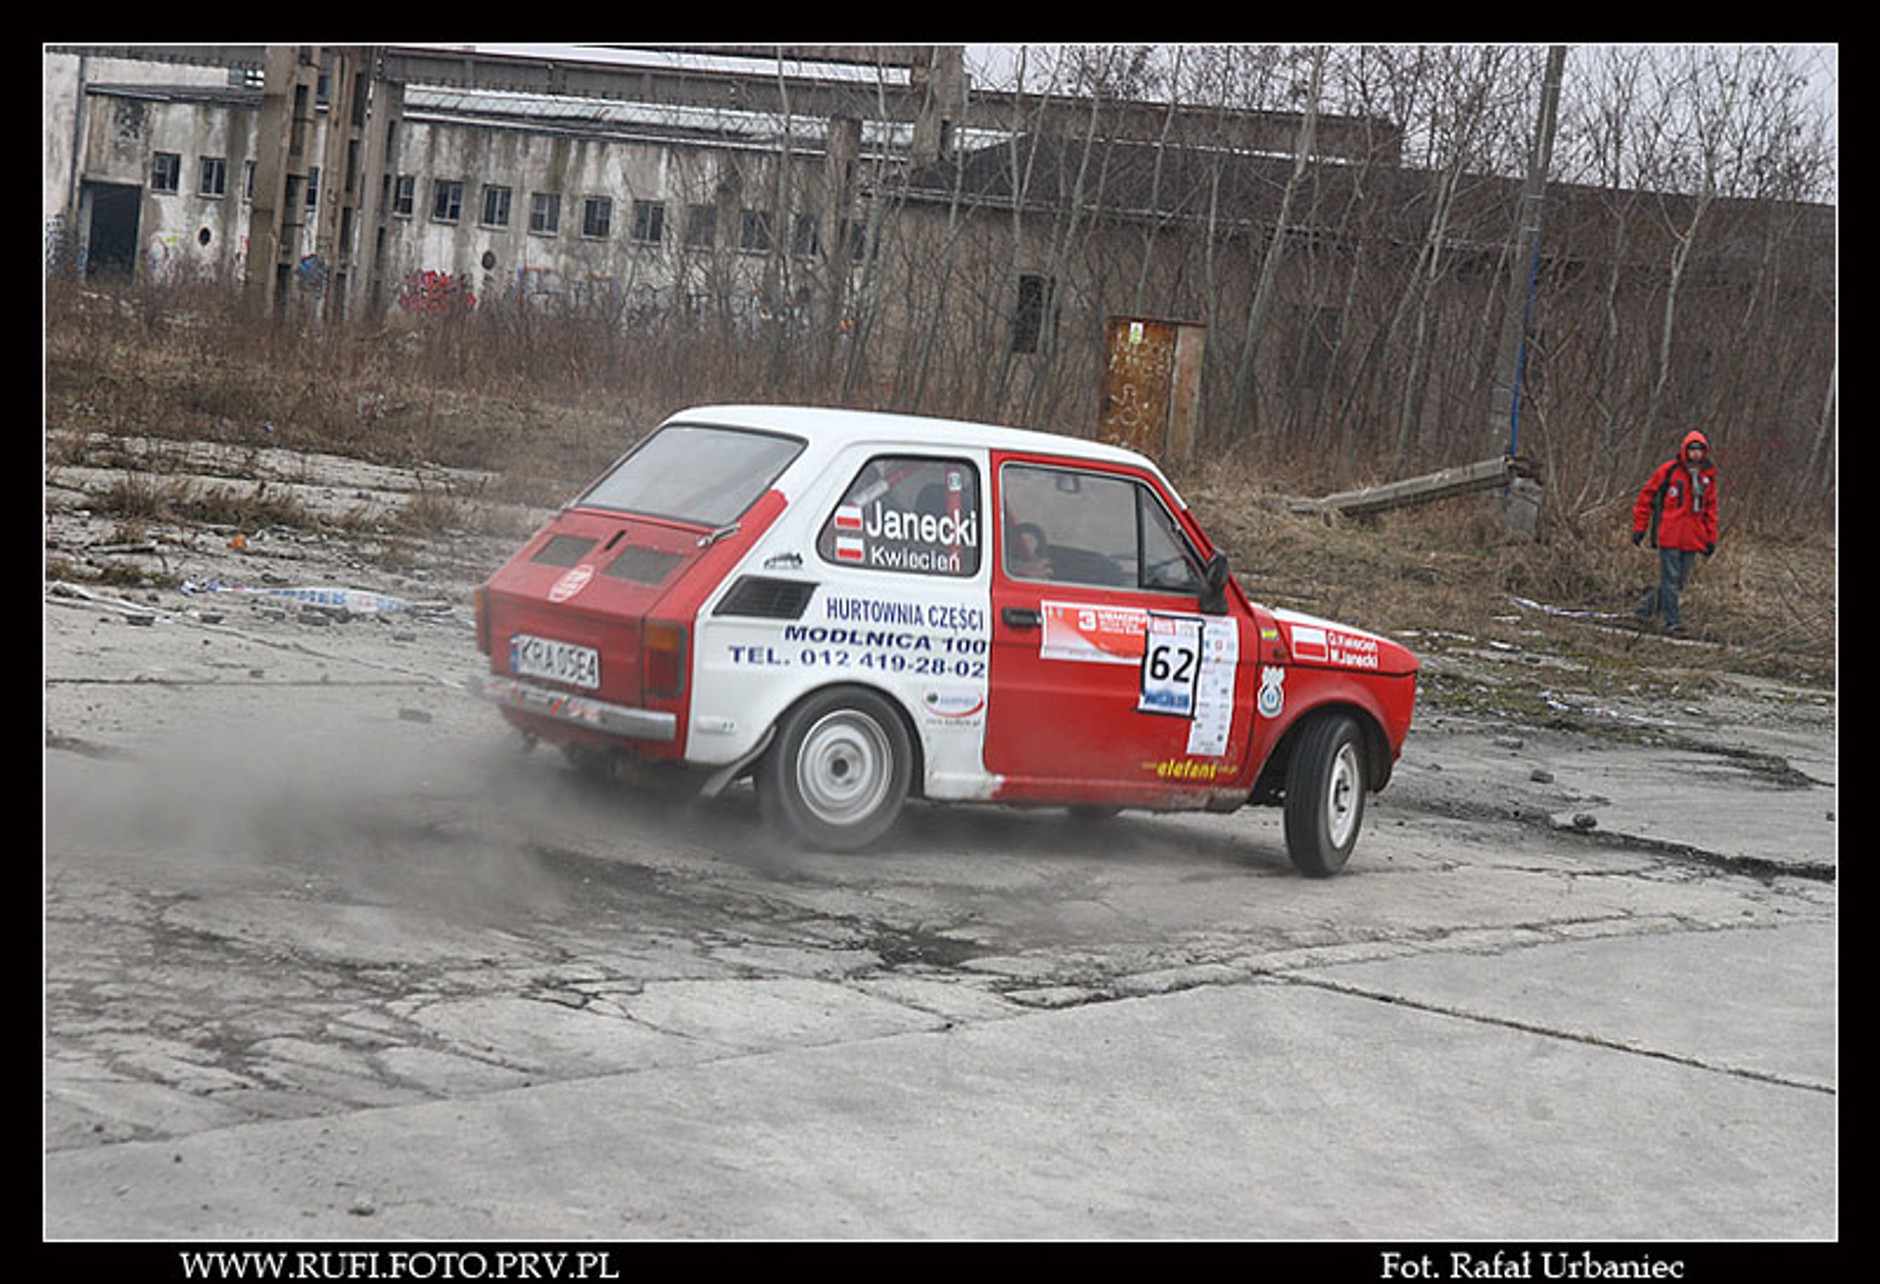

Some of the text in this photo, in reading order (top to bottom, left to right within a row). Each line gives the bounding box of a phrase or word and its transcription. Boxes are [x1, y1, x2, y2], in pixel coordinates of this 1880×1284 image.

[865, 501, 977, 547] Janecki
[871, 546, 961, 572] Kwiecień
[826, 597, 985, 635] HURTOWNIA CZĘŚCI
[1078, 611, 1097, 632] 3
[784, 625, 987, 655] MODLNICA 100
[728, 646, 986, 678] TEL. 012 419-28-02
[1150, 645, 1194, 683] 62
